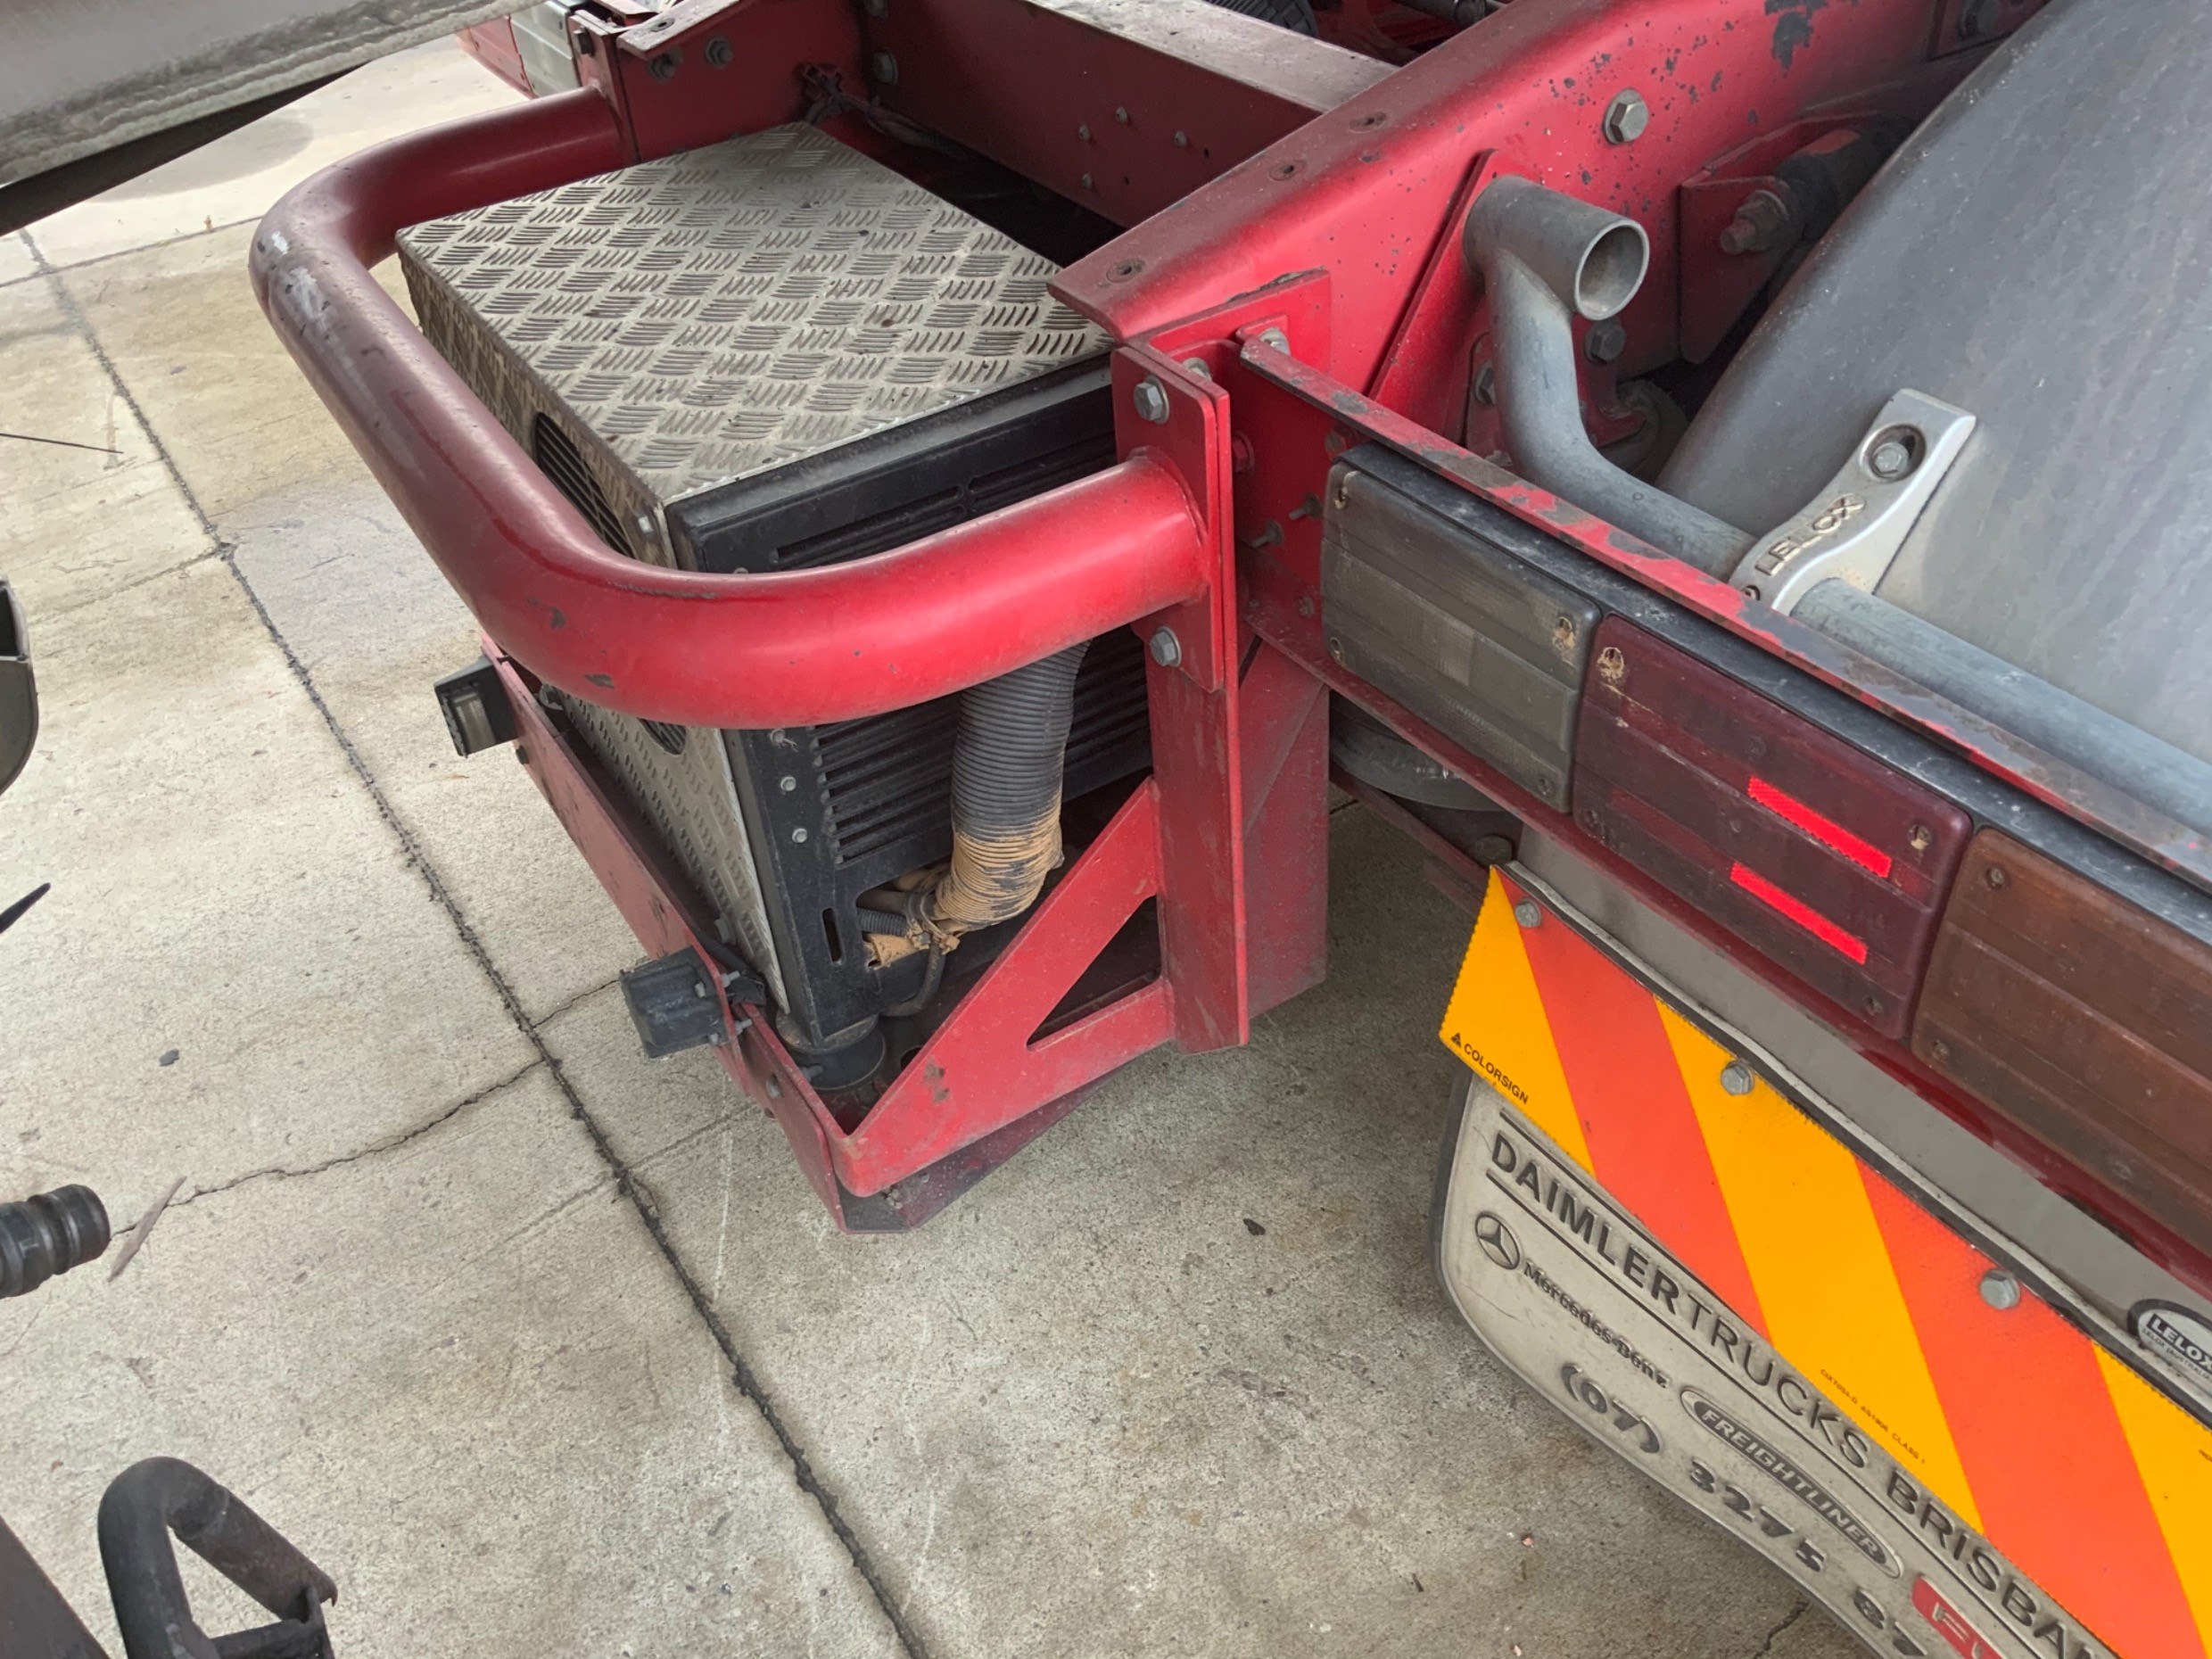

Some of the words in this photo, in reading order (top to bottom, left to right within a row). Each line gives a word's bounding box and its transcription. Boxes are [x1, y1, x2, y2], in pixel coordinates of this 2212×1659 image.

[1754, 493, 1865, 576] LELOX
[1463, 1043, 1529, 1105] COLORSIGN
[1523, 1259, 1671, 1389] Mercedes-Benz
[2150, 1317, 2212, 1369] LELOX
[1561, 1363, 1661, 1454] (07)
[1689, 1460, 1828, 1573] 3275
[1701, 1407, 1883, 1563] FREIGHTLINER
[1892, 1432, 1919, 1459] CLASS
